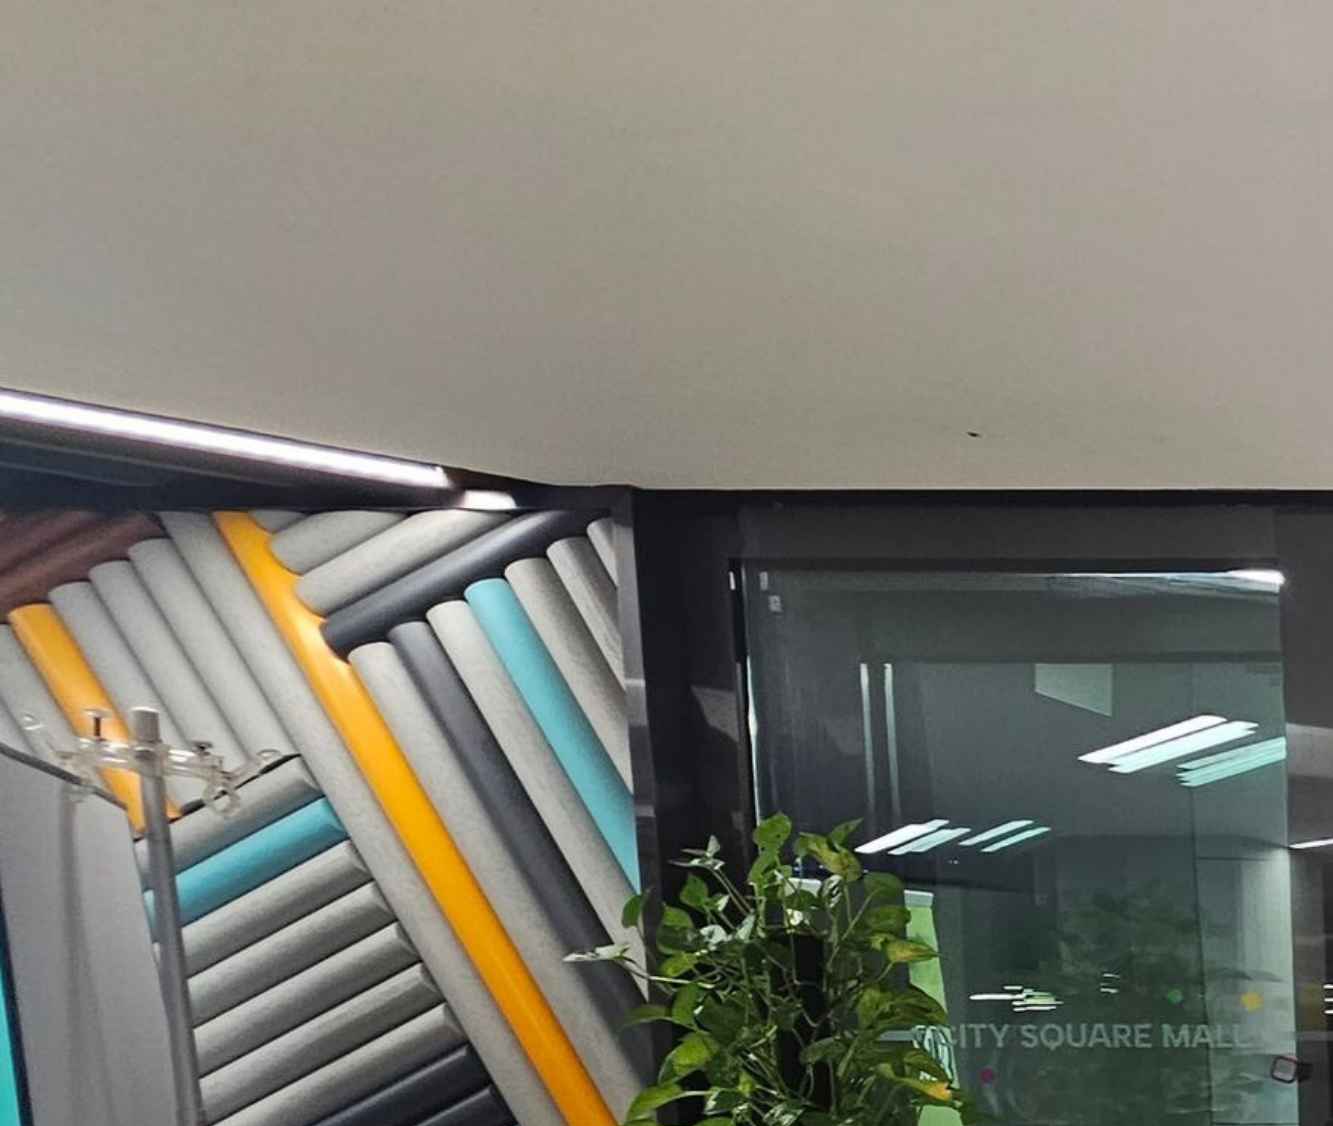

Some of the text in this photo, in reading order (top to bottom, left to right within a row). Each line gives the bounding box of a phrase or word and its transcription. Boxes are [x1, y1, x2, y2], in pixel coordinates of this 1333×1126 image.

[950, 1023, 1250, 1051] ITY SQUARE MALL
